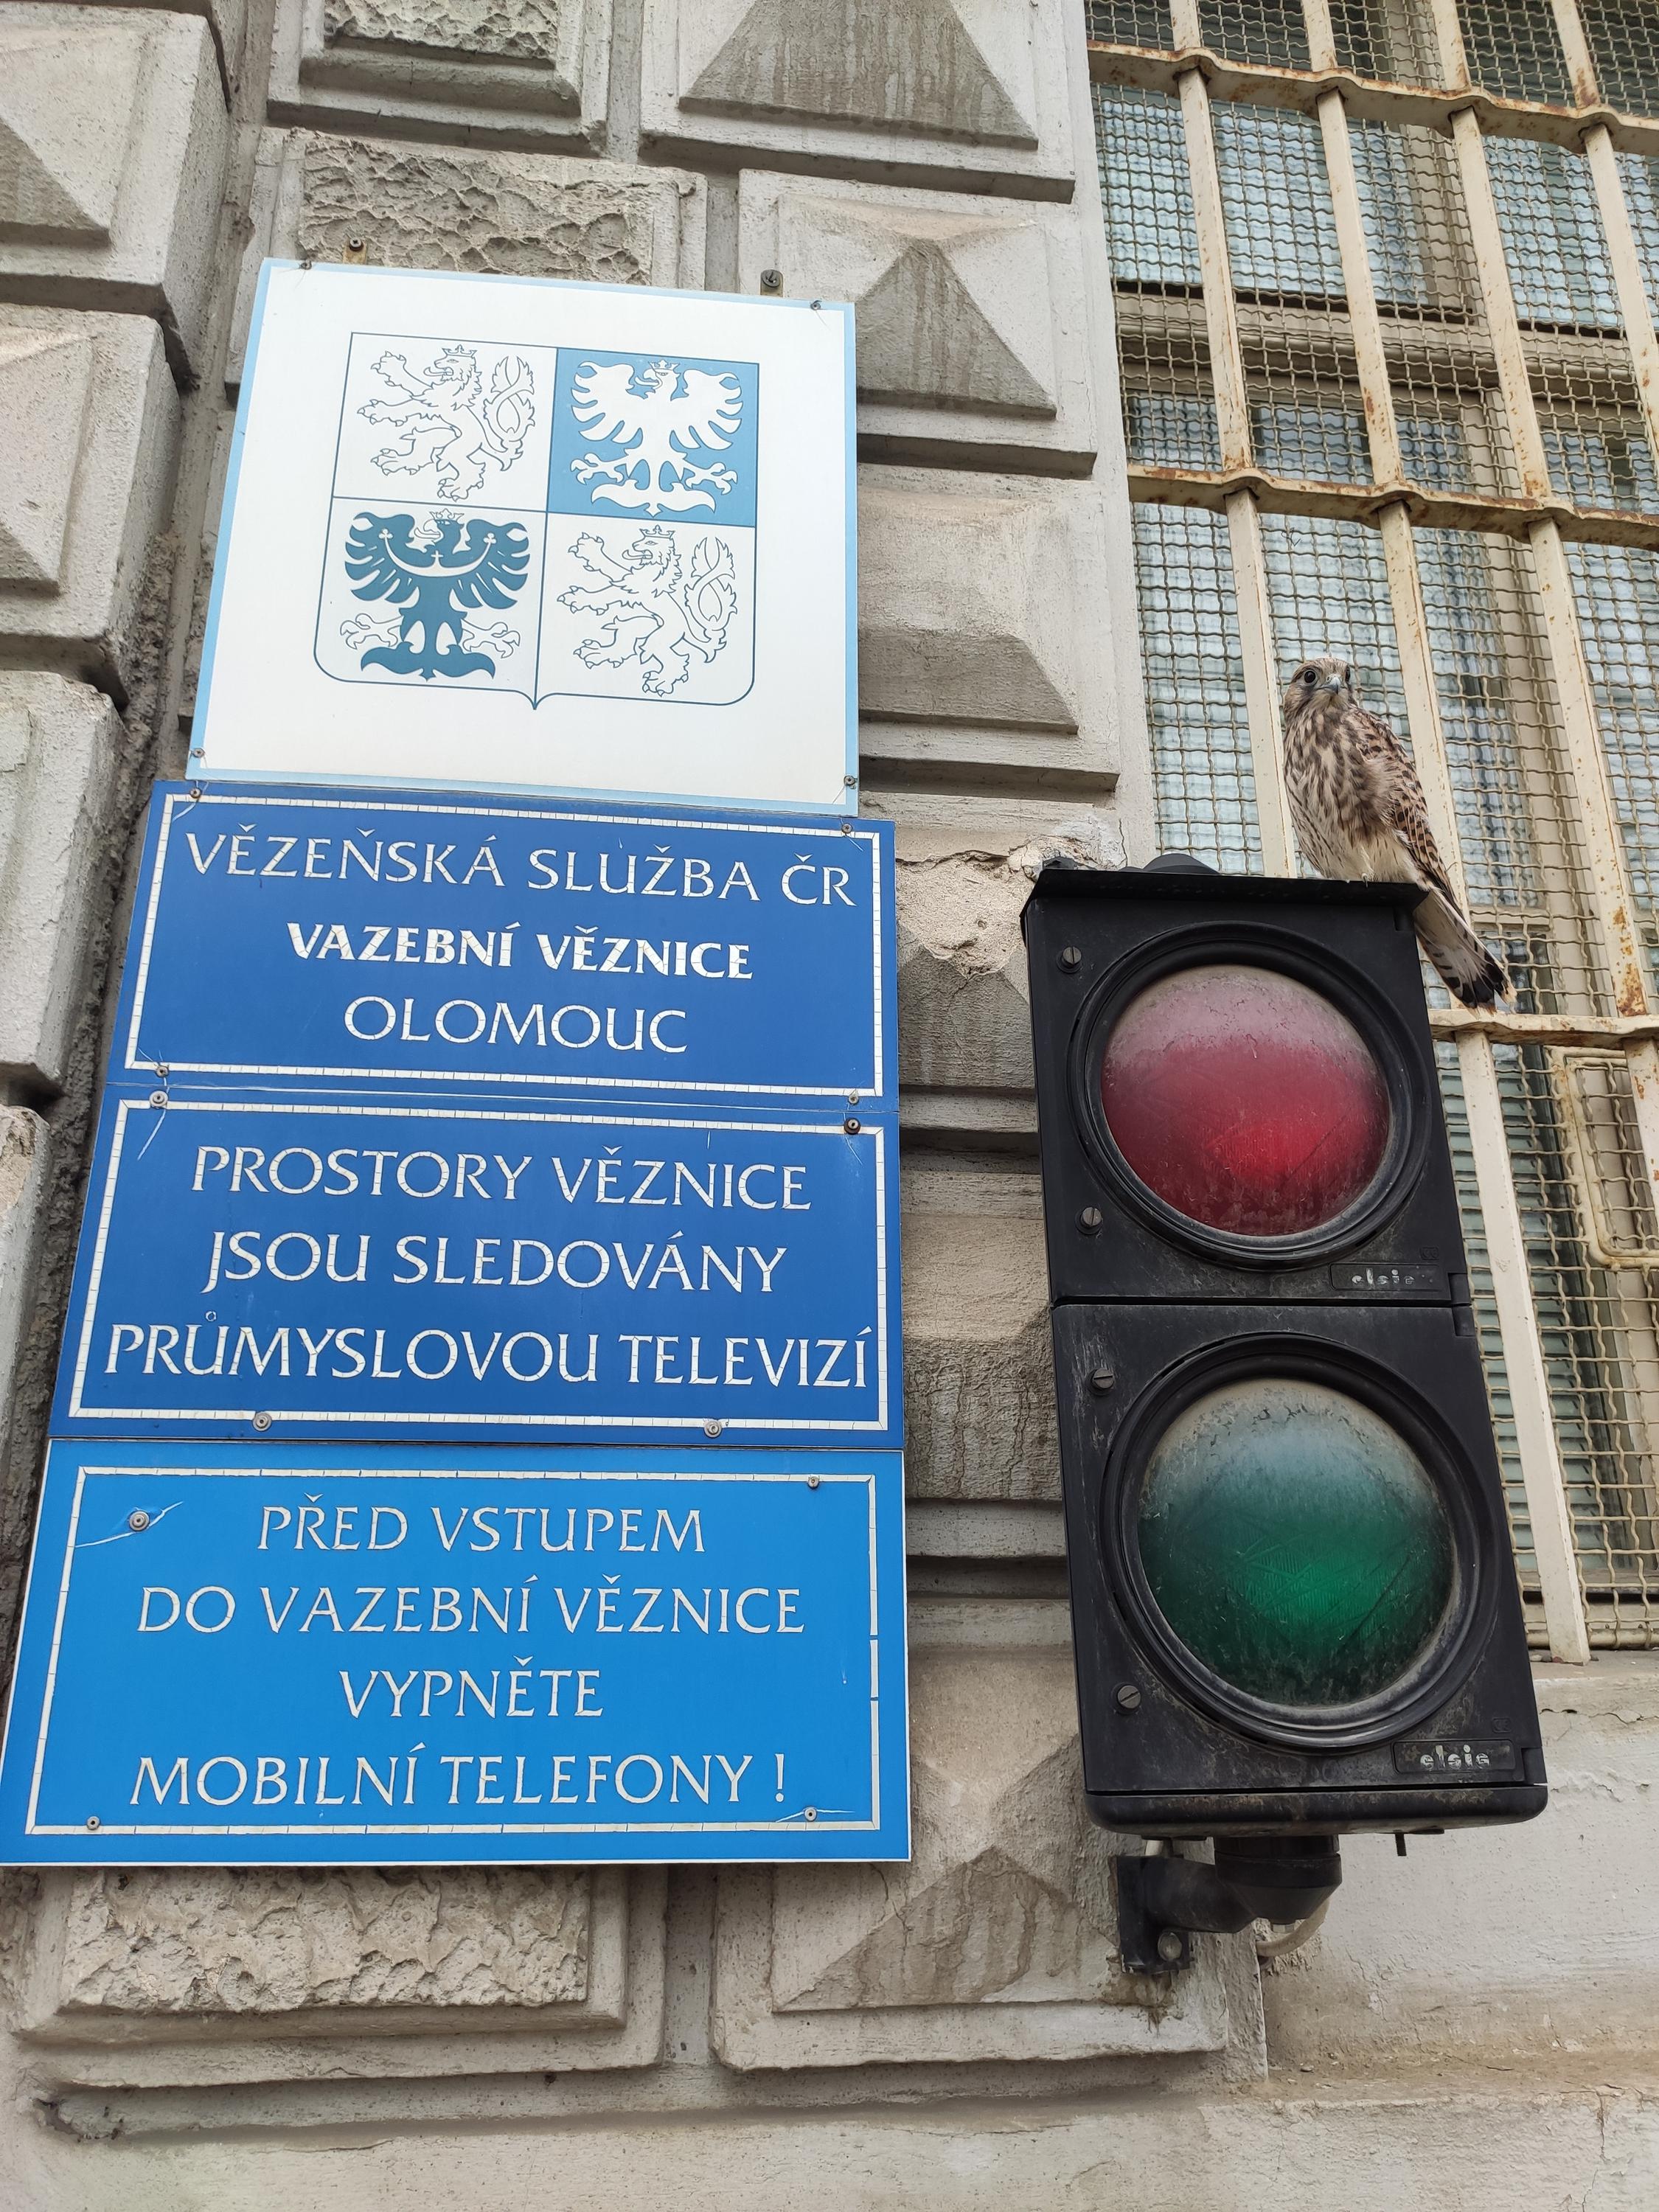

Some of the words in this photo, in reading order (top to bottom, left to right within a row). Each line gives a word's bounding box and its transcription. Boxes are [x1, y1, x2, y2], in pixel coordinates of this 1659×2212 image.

[185, 823, 506, 887] VĚZEŇSKÁ
[527, 844, 761, 902] SLUŽBA
[780, 853, 857, 907] ČR
[286, 920, 521, 968] VAZEBNÍ
[535, 925, 754, 981] VĚZNICE
[343, 995, 688, 1054] OLOMOUC
[191, 1145, 533, 1200] PROSTORY
[551, 1146, 812, 1211] VĚZNICE
[201, 1230, 371, 1294] JSOU
[392, 1230, 787, 1294] SLEDOVÁNY
[104, 1310, 599, 1383] PRŮMYSLOVOU
[618, 1325, 873, 1388] TELEVIZÍ
[257, 1493, 408, 1551] PŘED
[431, 1506, 706, 1553] VSTUPEM
[137, 1585, 237, 1634] DO
[260, 1573, 538, 1634] VAZEBNÍ
[554, 1574, 804, 1635] VĚZNICE
[338, 1656, 603, 1719] VYPNĚTE
[129, 1742, 426, 1806] MOBILNÍ
[439, 1753, 754, 1805] TELEFONY
[775, 1753, 785, 1803] !
